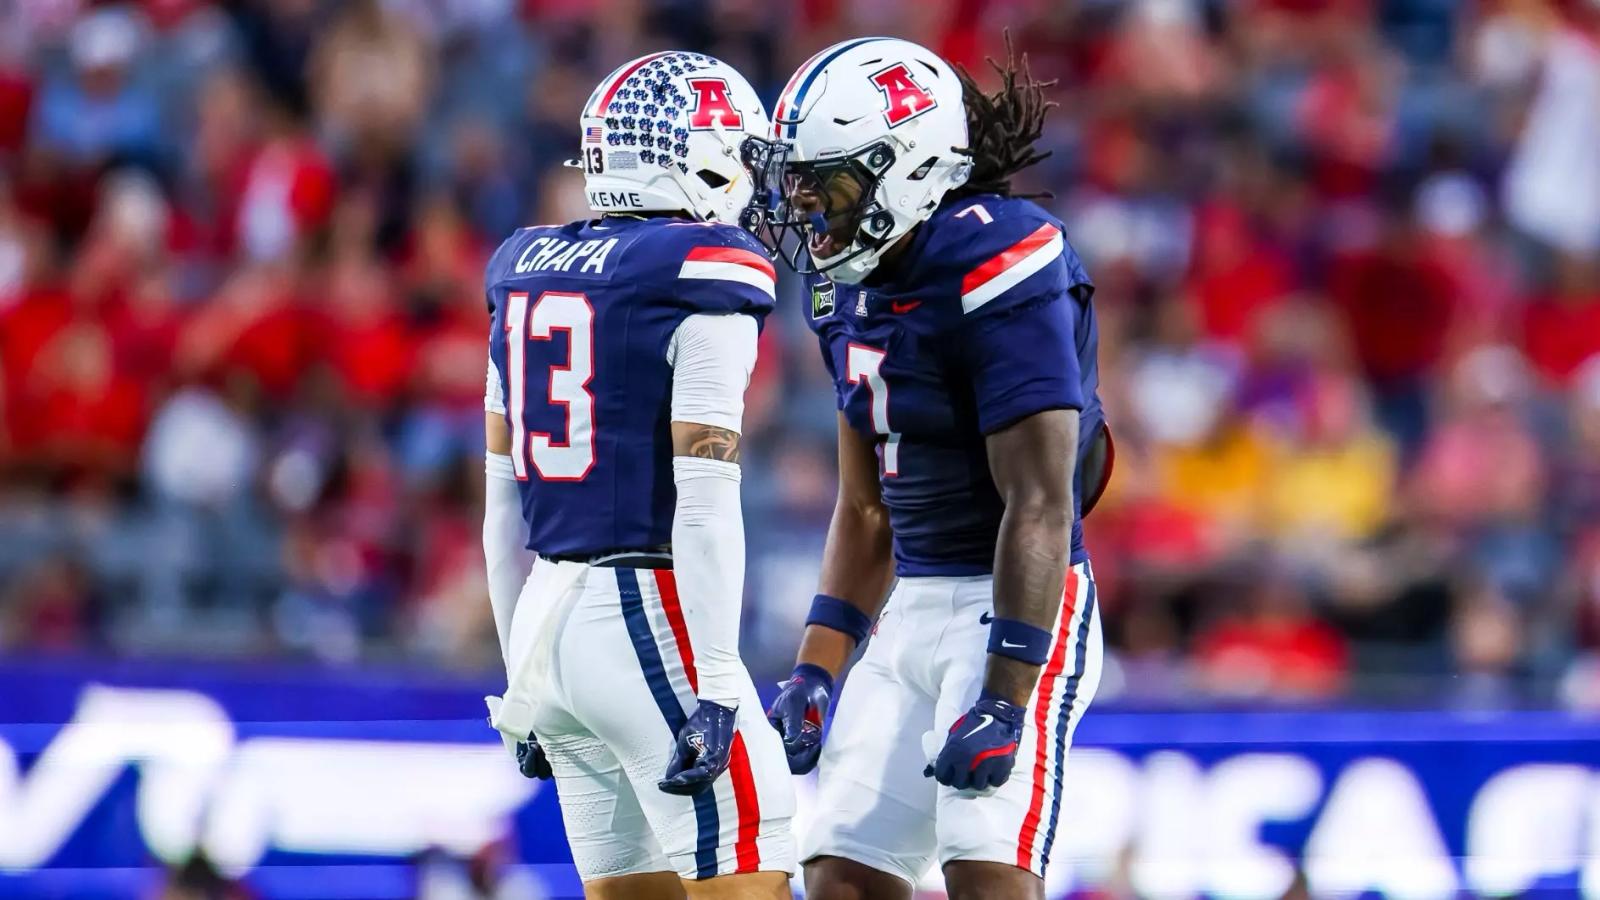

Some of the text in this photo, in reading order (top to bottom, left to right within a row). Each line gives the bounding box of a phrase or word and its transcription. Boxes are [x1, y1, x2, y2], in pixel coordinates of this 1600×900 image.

[685, 76, 745, 132] A
[868, 61, 938, 129] A
[586, 147, 604, 174] 13
[589, 191, 644, 208] KEME
[514, 236, 620, 275] CHAPA
[505, 290, 597, 482] 13
[846, 342, 902, 478] 7
